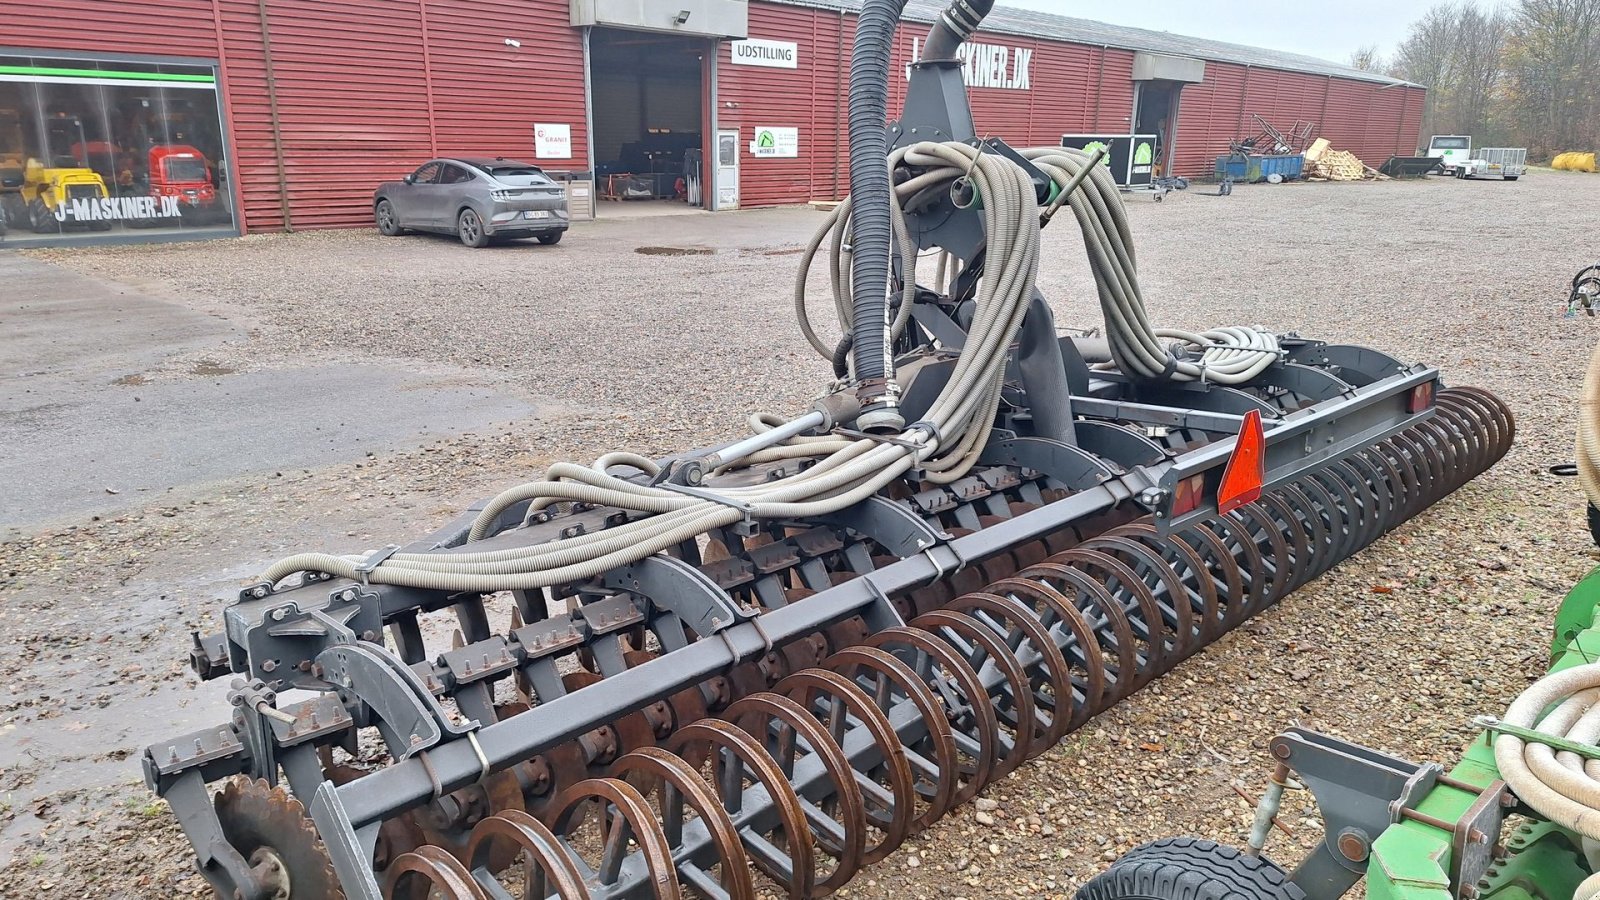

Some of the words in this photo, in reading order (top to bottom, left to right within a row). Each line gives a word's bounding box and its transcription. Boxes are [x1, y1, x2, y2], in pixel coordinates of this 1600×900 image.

[737, 44, 792, 61] UDSTILLING
[905, 36, 1033, 90] JSKINER.DK
[55, 195, 182, 222] J-MASKINER.DK
